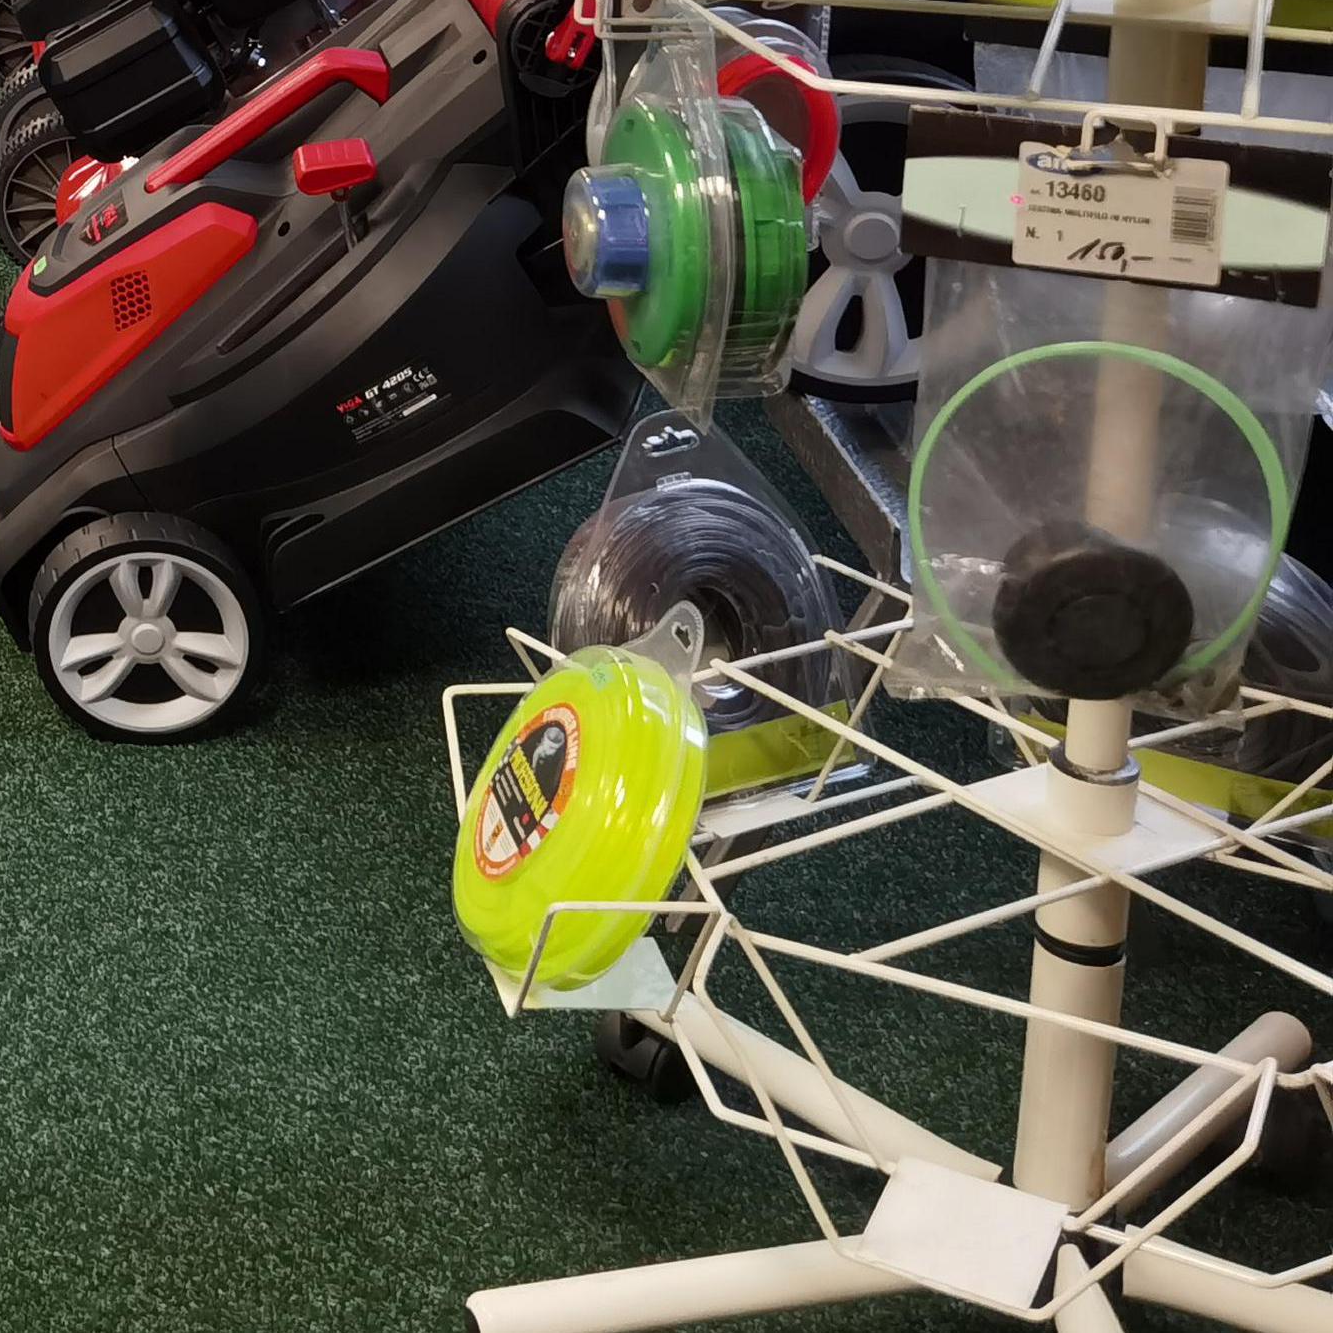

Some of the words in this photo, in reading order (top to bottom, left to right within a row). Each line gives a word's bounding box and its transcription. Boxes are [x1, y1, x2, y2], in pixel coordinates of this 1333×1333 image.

[1045, 179, 1107, 203] 13460
[1025, 225, 1041, 240] N.
[1056, 229, 1064, 242] 1
[364, 385, 380, 400] GT
